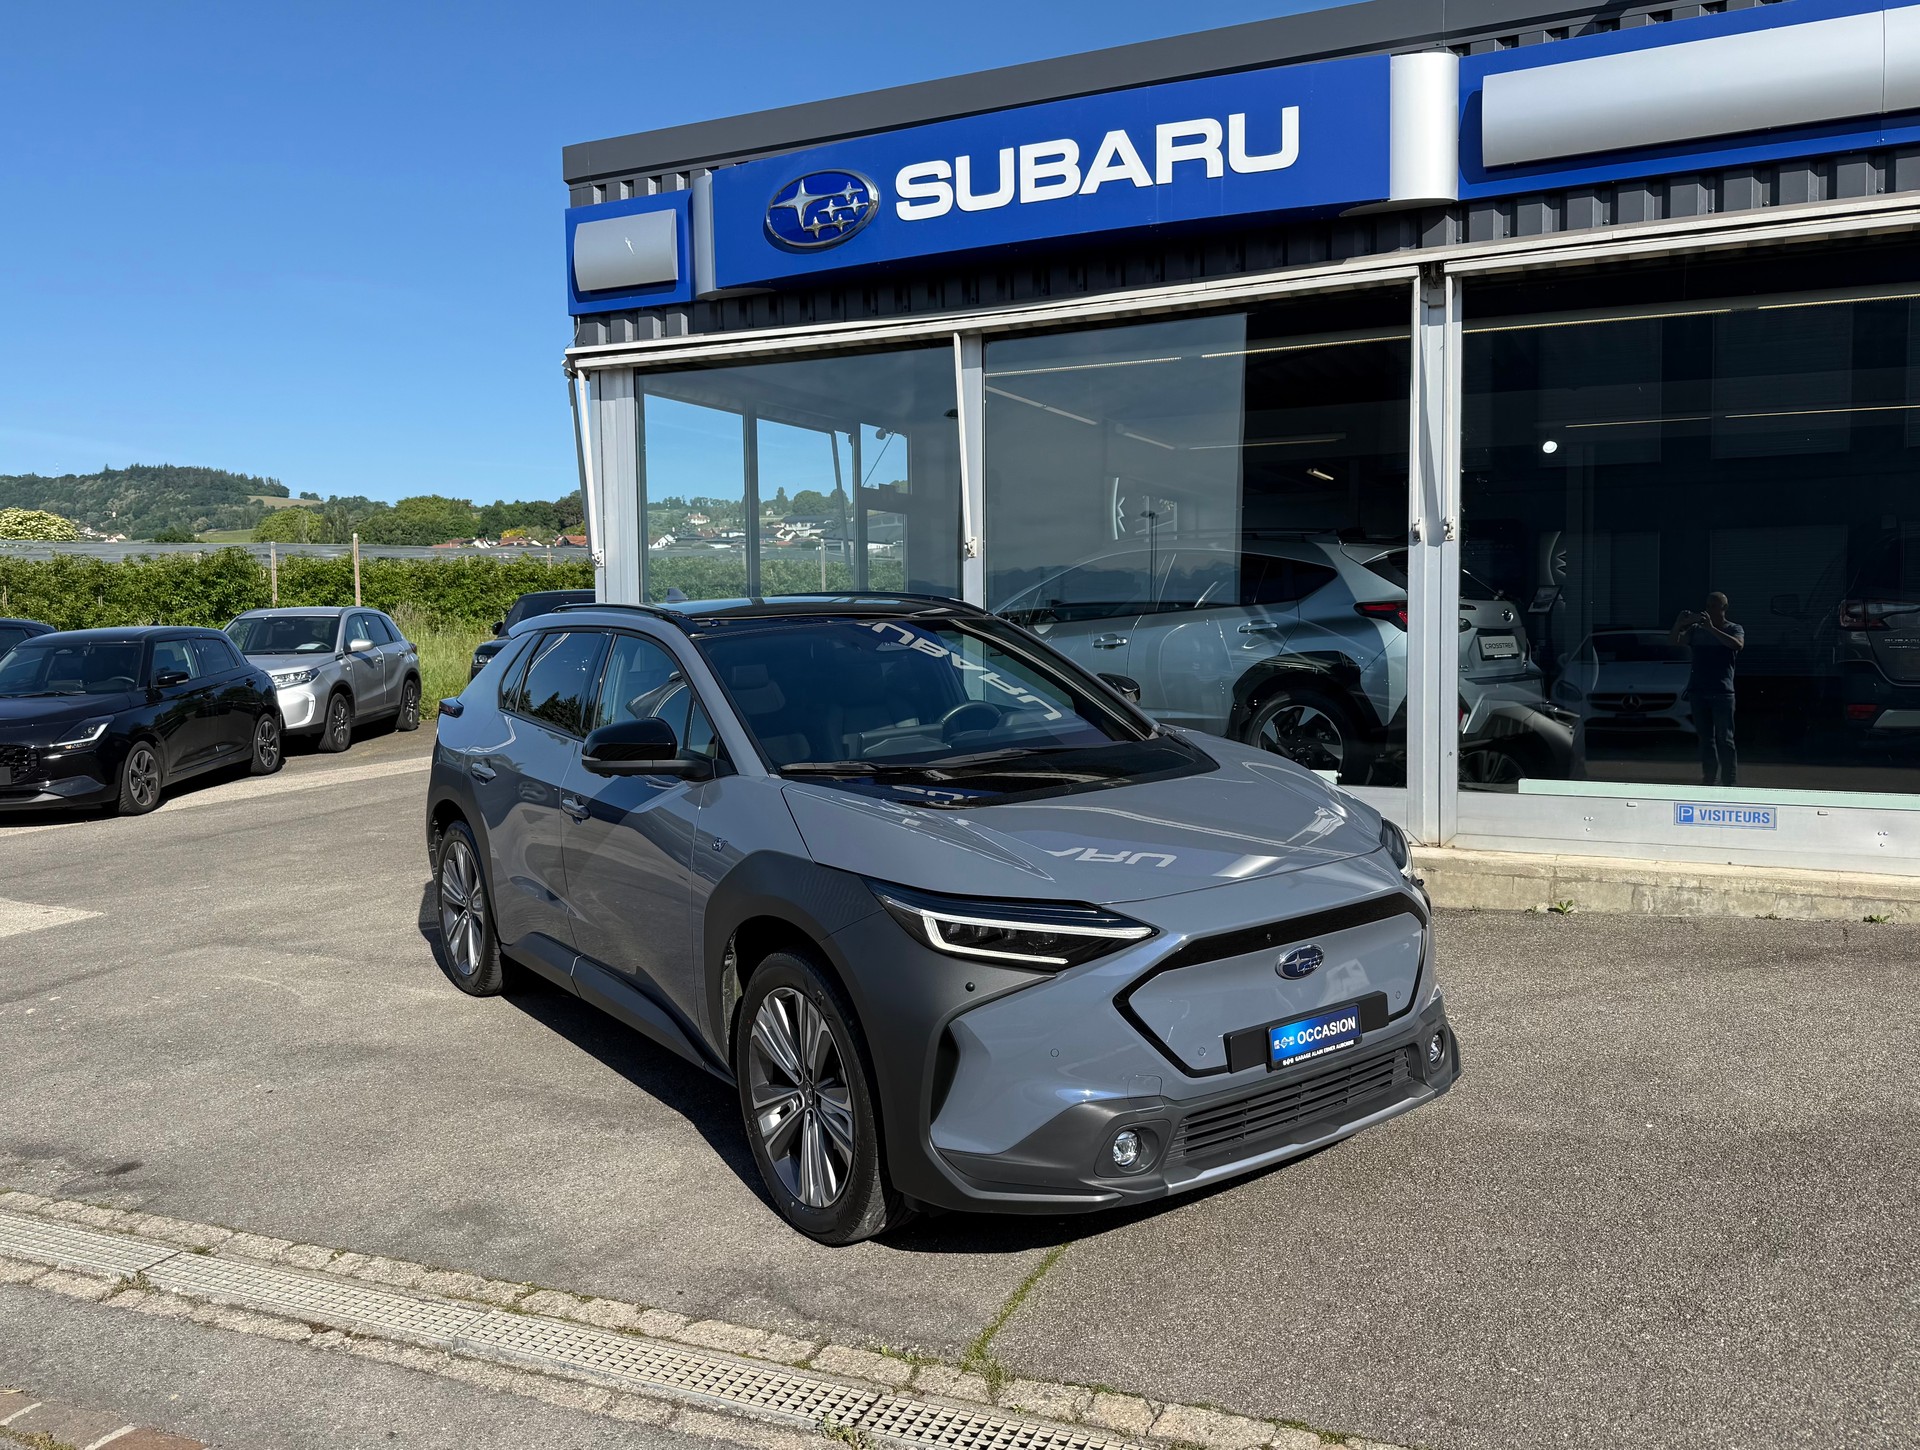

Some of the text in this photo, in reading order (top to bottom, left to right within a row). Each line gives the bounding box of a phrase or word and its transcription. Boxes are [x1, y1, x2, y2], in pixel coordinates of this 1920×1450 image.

[896, 106, 1299, 221] SUBARU
[1680, 807, 1770, 823] P VISITEURS
[1297, 1016, 1355, 1044] OCCASION
[1295, 1053, 1311, 1062] GARAGE
[1312, 1048, 1324, 1057] ALAIN
